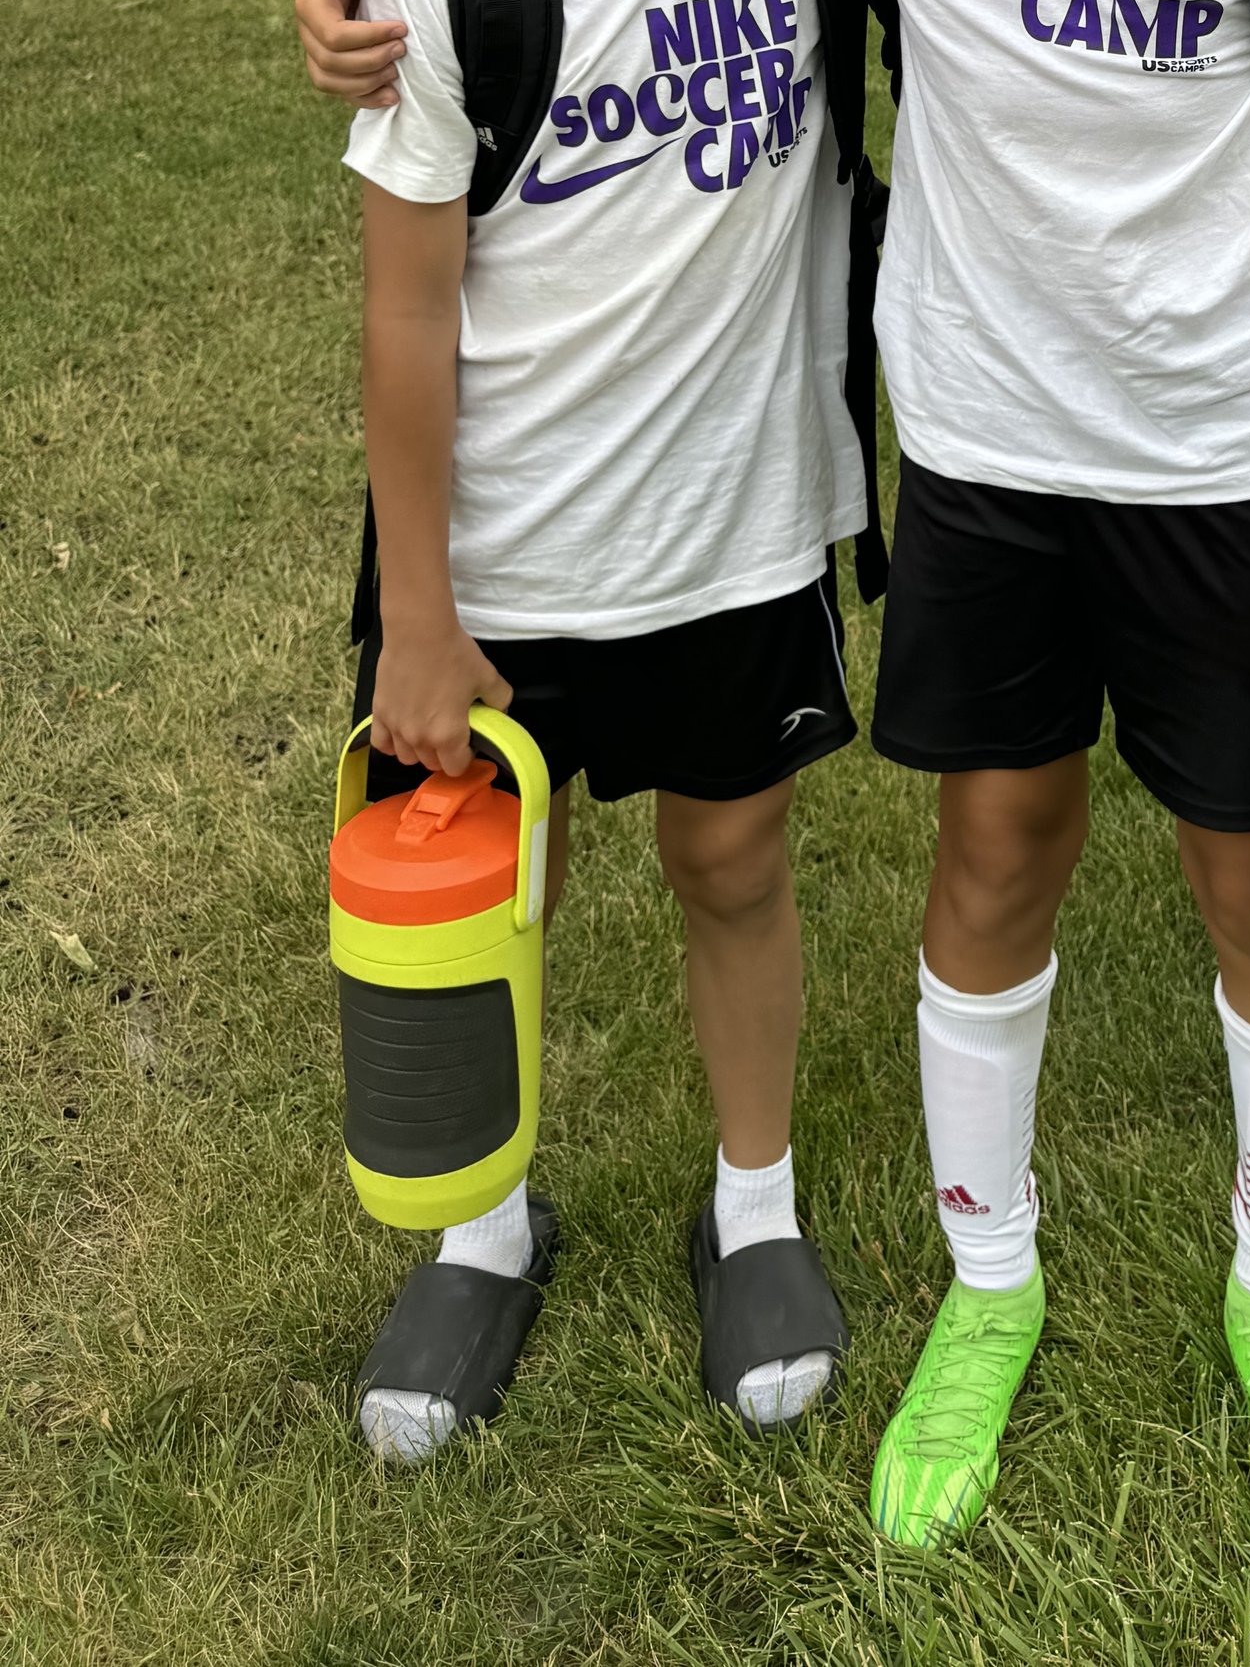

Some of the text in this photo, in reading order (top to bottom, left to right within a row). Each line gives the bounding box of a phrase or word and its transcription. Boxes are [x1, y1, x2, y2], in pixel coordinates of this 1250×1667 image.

[1142, 59, 1170, 73] US
[1171, 65, 1206, 73] CAMPS
[550, 48, 794, 148] SOCCER
